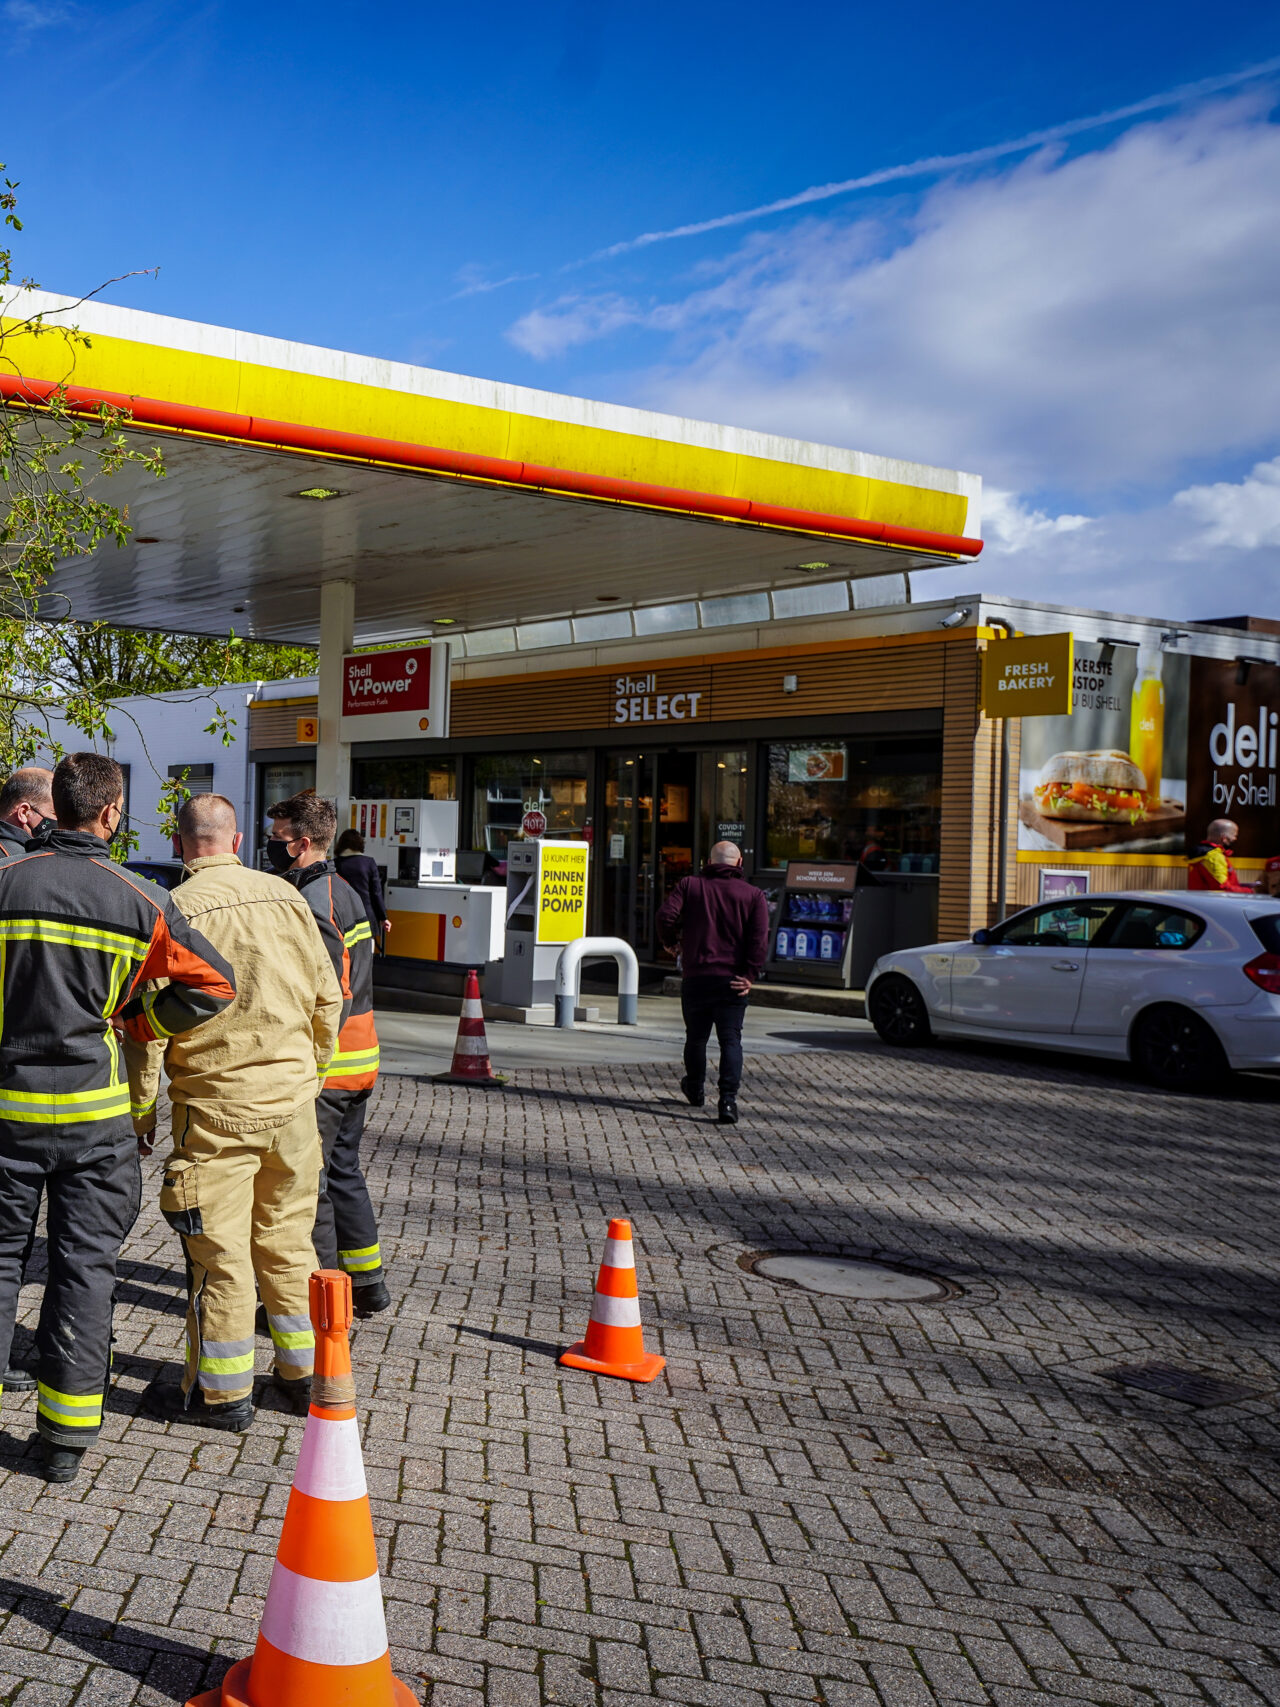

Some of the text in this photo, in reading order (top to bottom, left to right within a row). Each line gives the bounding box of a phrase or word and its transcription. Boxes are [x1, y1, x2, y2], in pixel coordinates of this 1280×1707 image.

[348, 663, 372, 678] Shell
[1005, 662, 1049, 677] FRESH
[348, 678, 412, 697] V-Power
[615, 673, 656, 696] Shell
[998, 676, 1055, 691] BAKERY
[614, 692, 702, 723] SELECT
[1095, 695, 1121, 711] SHELL
[304, 723, 314, 737] 3
[1139, 718, 1155, 731] deli
[1209, 702, 1279, 769] deli
[1213, 770, 1277, 814] by Shell
[543, 854, 585, 864] U KUNT HIER
[543, 870, 584, 882] PINNEN
[543, 884, 584, 896] AAN DE
[542, 898, 583, 913] POMP
